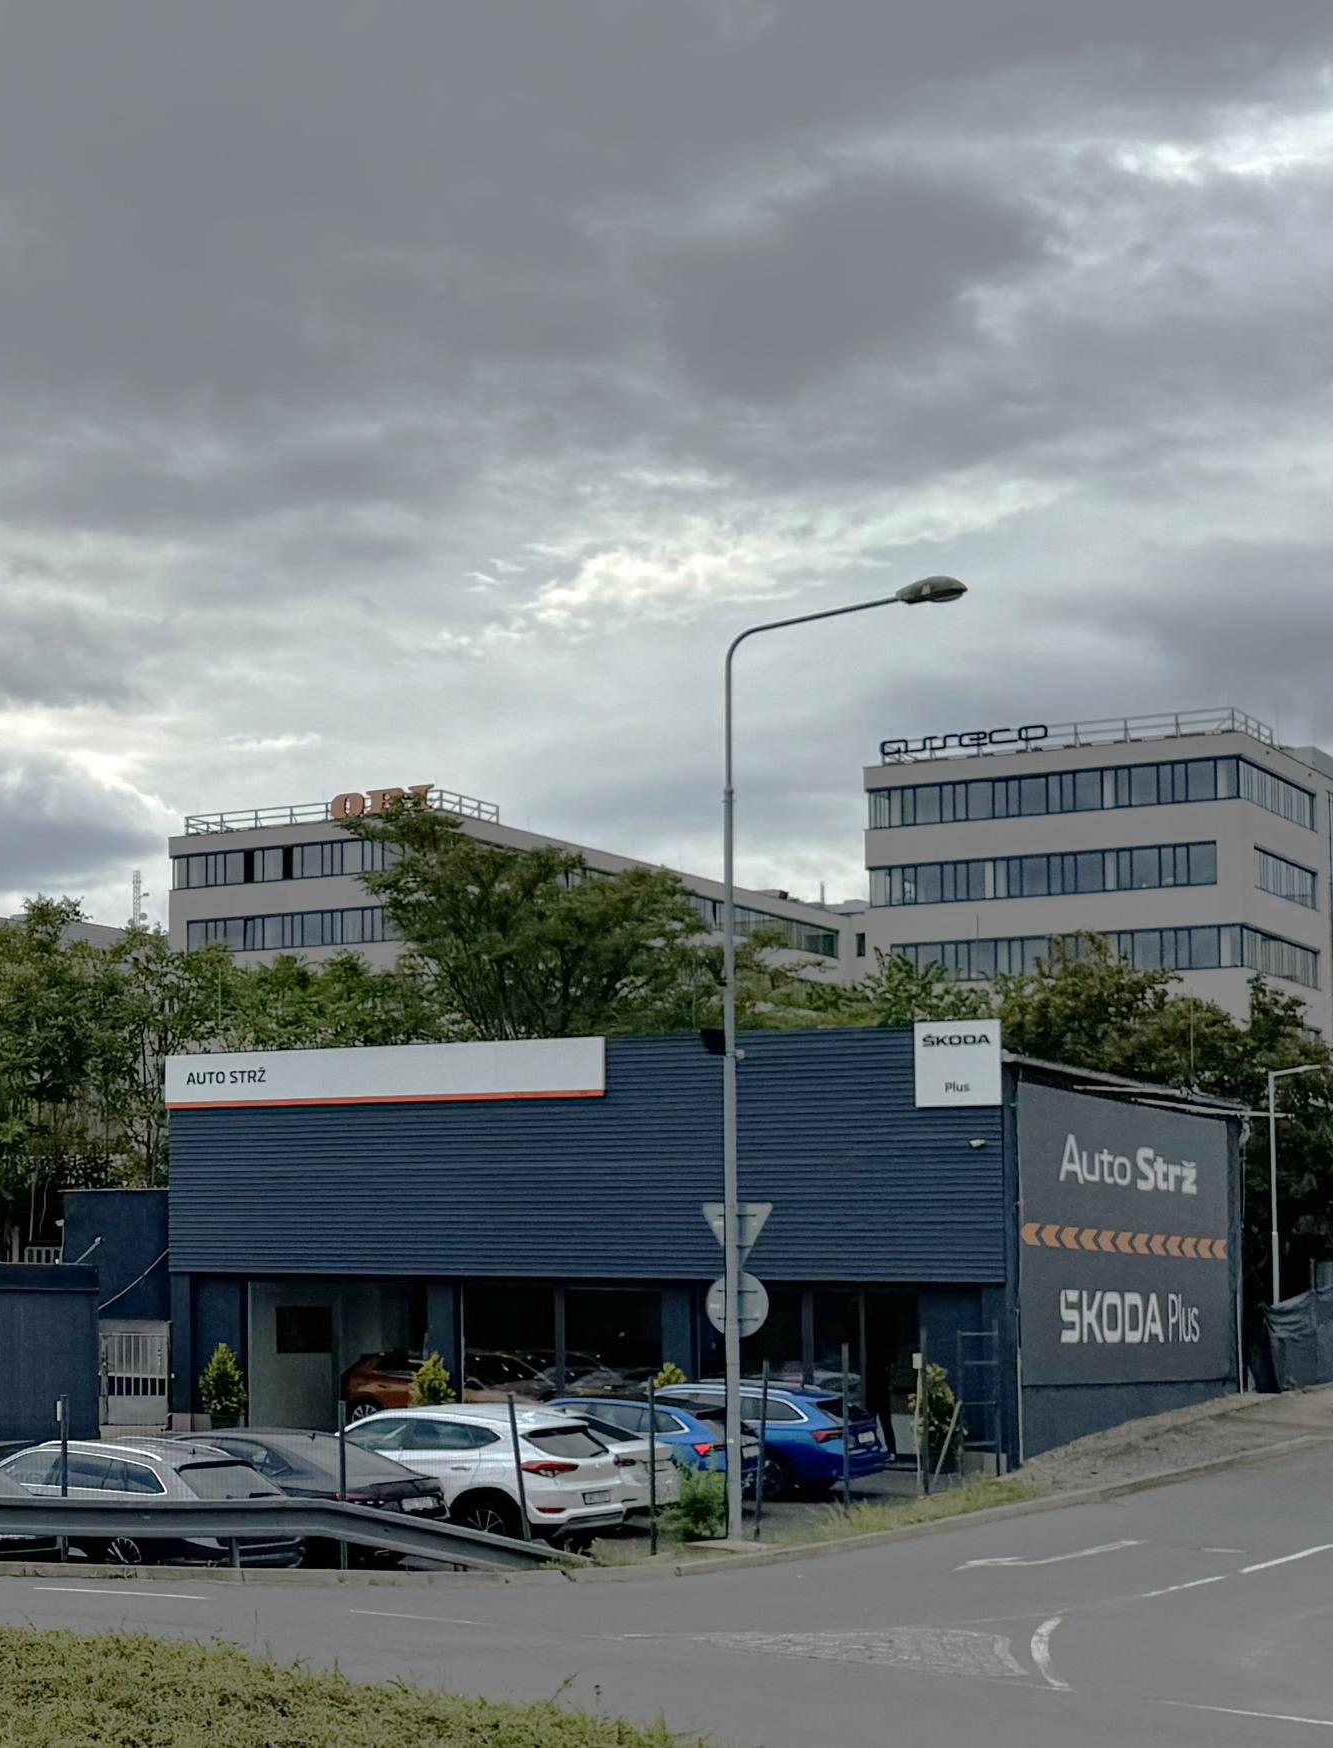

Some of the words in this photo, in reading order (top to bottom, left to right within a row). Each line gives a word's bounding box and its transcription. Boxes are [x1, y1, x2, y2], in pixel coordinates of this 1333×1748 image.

[186, 1071, 226, 1086] AUTO
[229, 1066, 267, 1084] STRŽ
[944, 1081, 970, 1093] Plus
[1059, 1133, 1132, 1186] Auto
[1136, 1146, 1198, 1195] Strž
[1168, 1292, 1200, 1343] Plus
